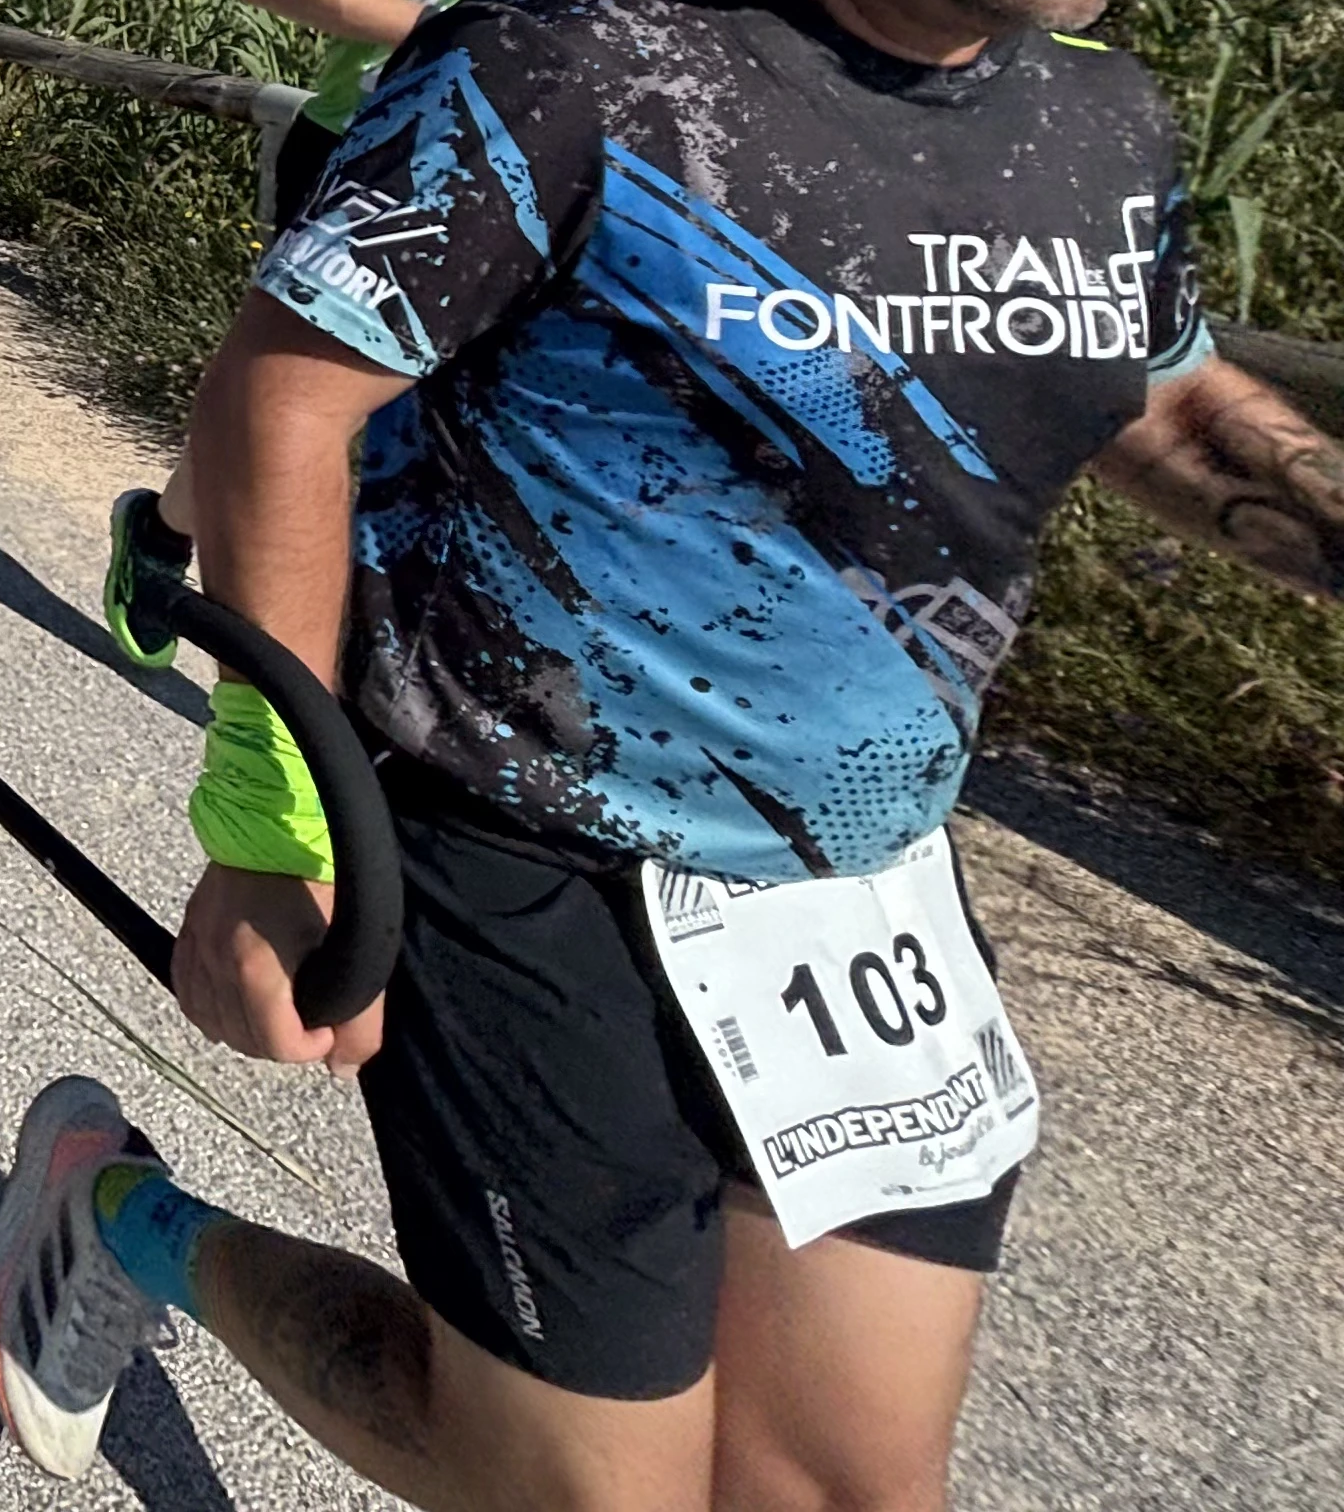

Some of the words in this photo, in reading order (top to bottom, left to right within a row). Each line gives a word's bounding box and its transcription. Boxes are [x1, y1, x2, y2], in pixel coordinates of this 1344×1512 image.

[908, 233, 1110, 296] TRAIL
[705, 283, 1148, 359] FONTFROIDE
[781, 932, 947, 1057] 103
[486, 1189, 545, 1341] SALOMON
